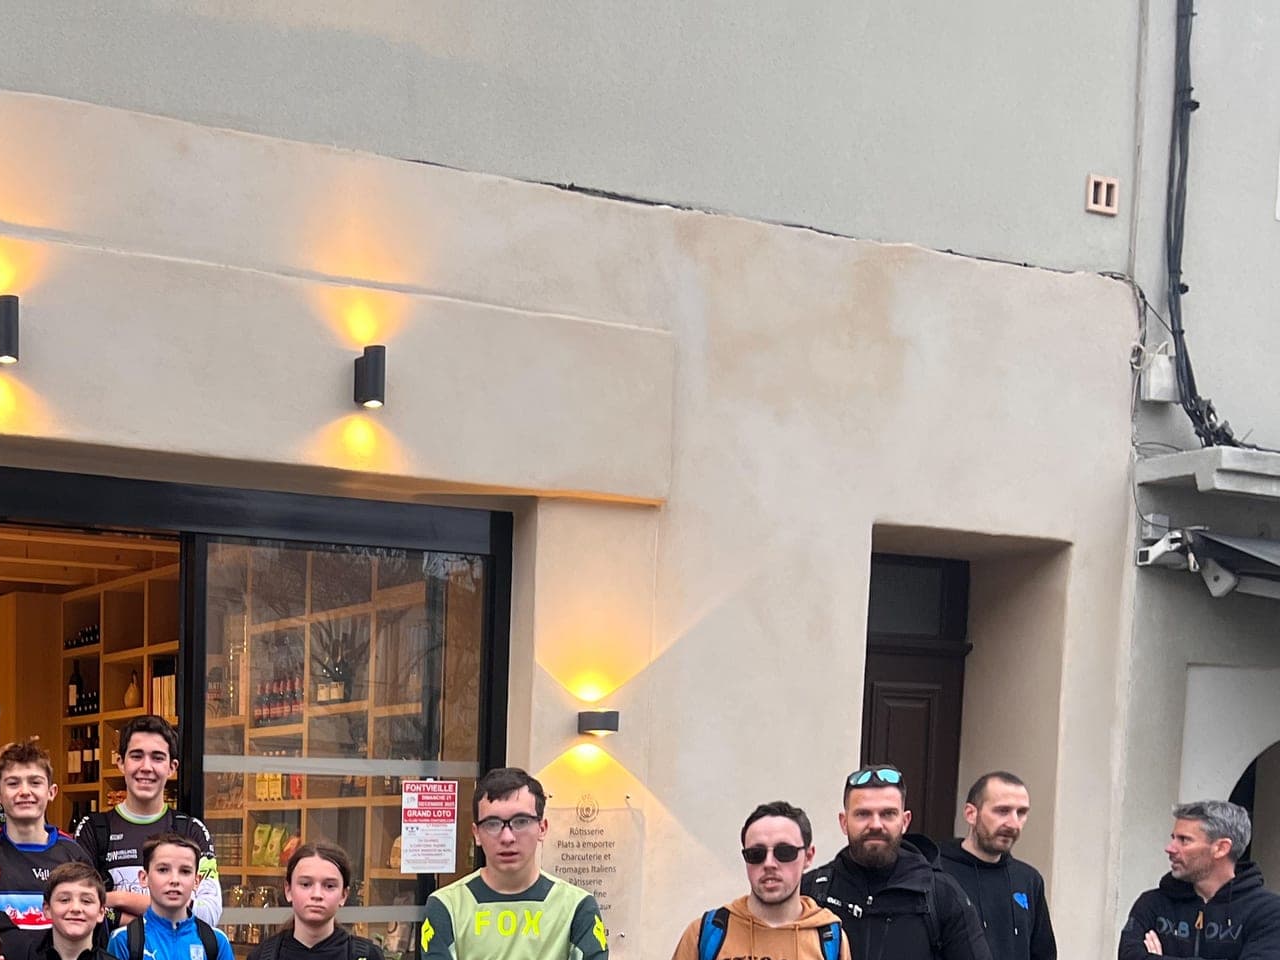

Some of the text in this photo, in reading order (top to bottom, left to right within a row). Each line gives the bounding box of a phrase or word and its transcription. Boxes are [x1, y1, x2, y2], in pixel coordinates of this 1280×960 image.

[405, 784, 453, 792] FONTVIEILLE
[570, 828, 604, 836] Rôtisserie
[557, 841, 574, 849] Plats
[582, 841, 615, 851] emporter
[561, 853, 611, 861] Charcuterie et
[555, 865, 616, 875] Fromages Italiens
[474, 909, 544, 937] FOX
